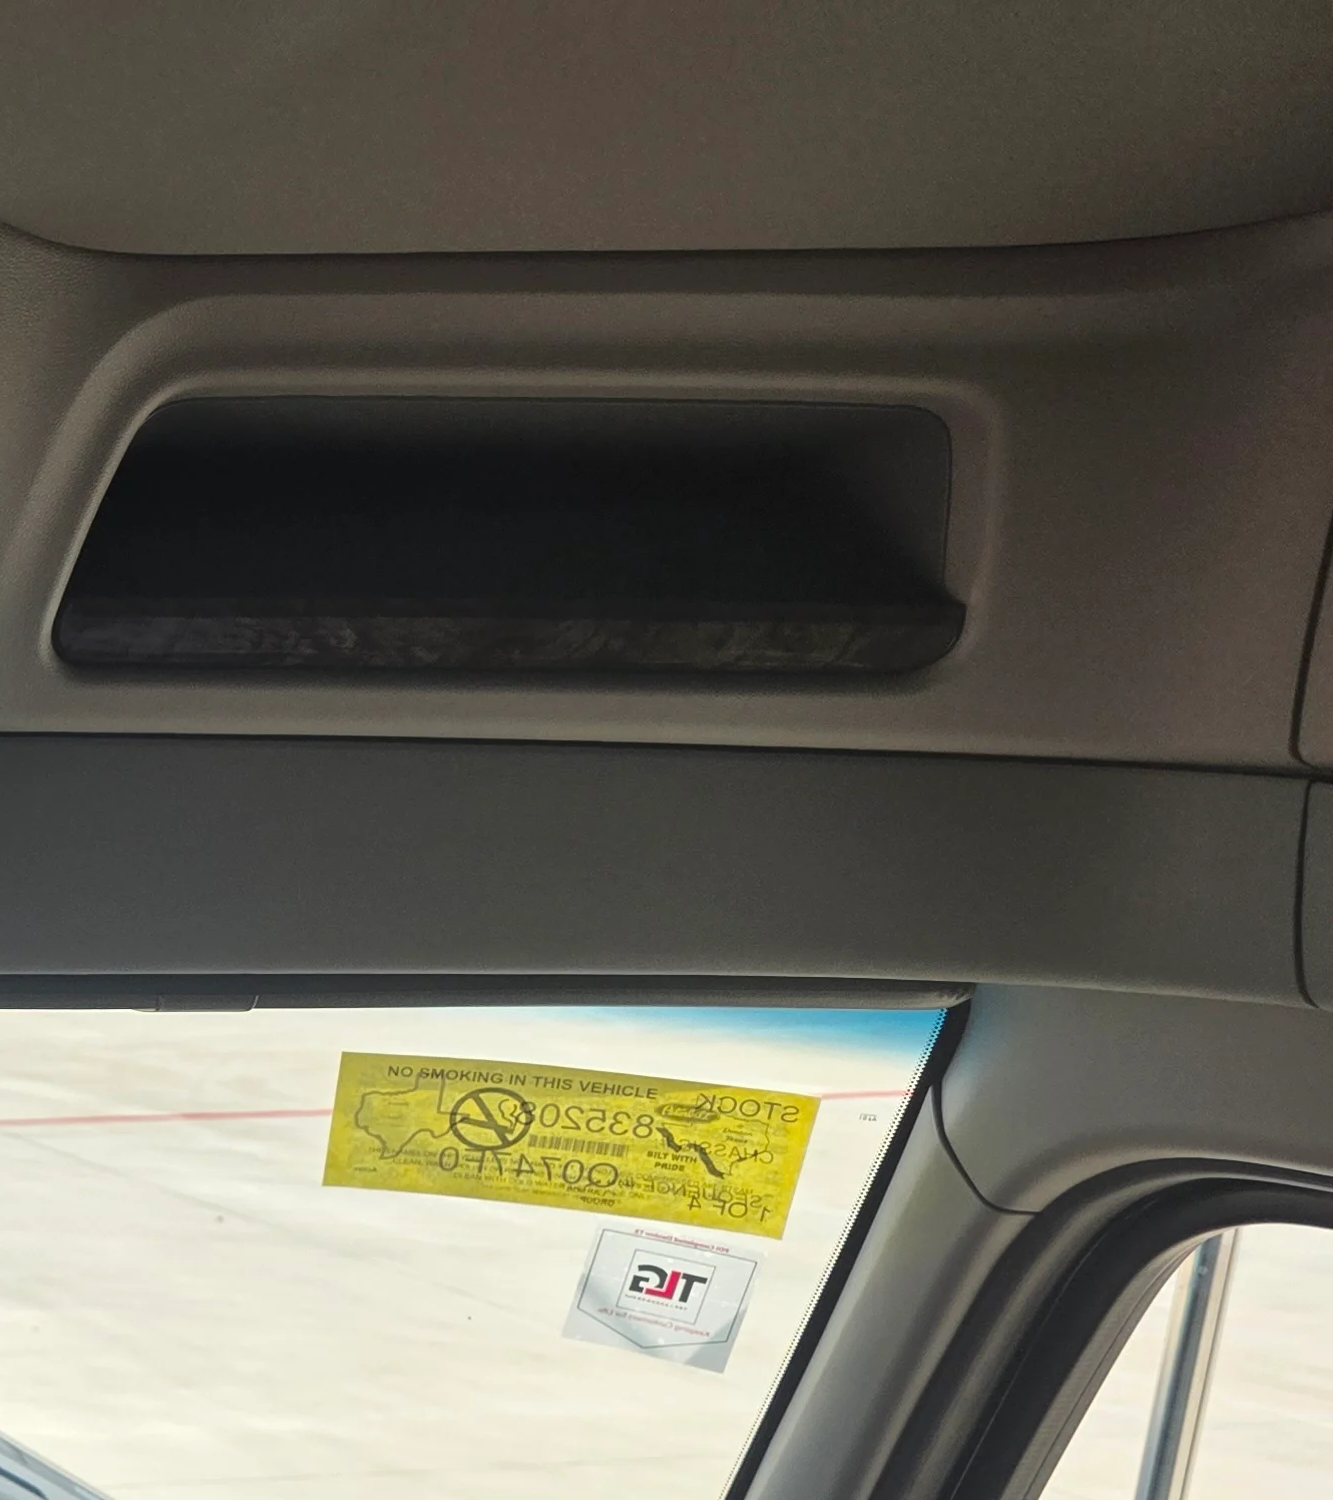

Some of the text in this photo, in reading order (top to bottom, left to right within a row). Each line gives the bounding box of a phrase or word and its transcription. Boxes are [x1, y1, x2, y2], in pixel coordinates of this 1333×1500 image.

[386, 1065, 659, 1101] NO SMOKING IN THIS VEHICLE
[672, 1153, 697, 1164] WITH
[654, 1161, 685, 1173] PRIDE
